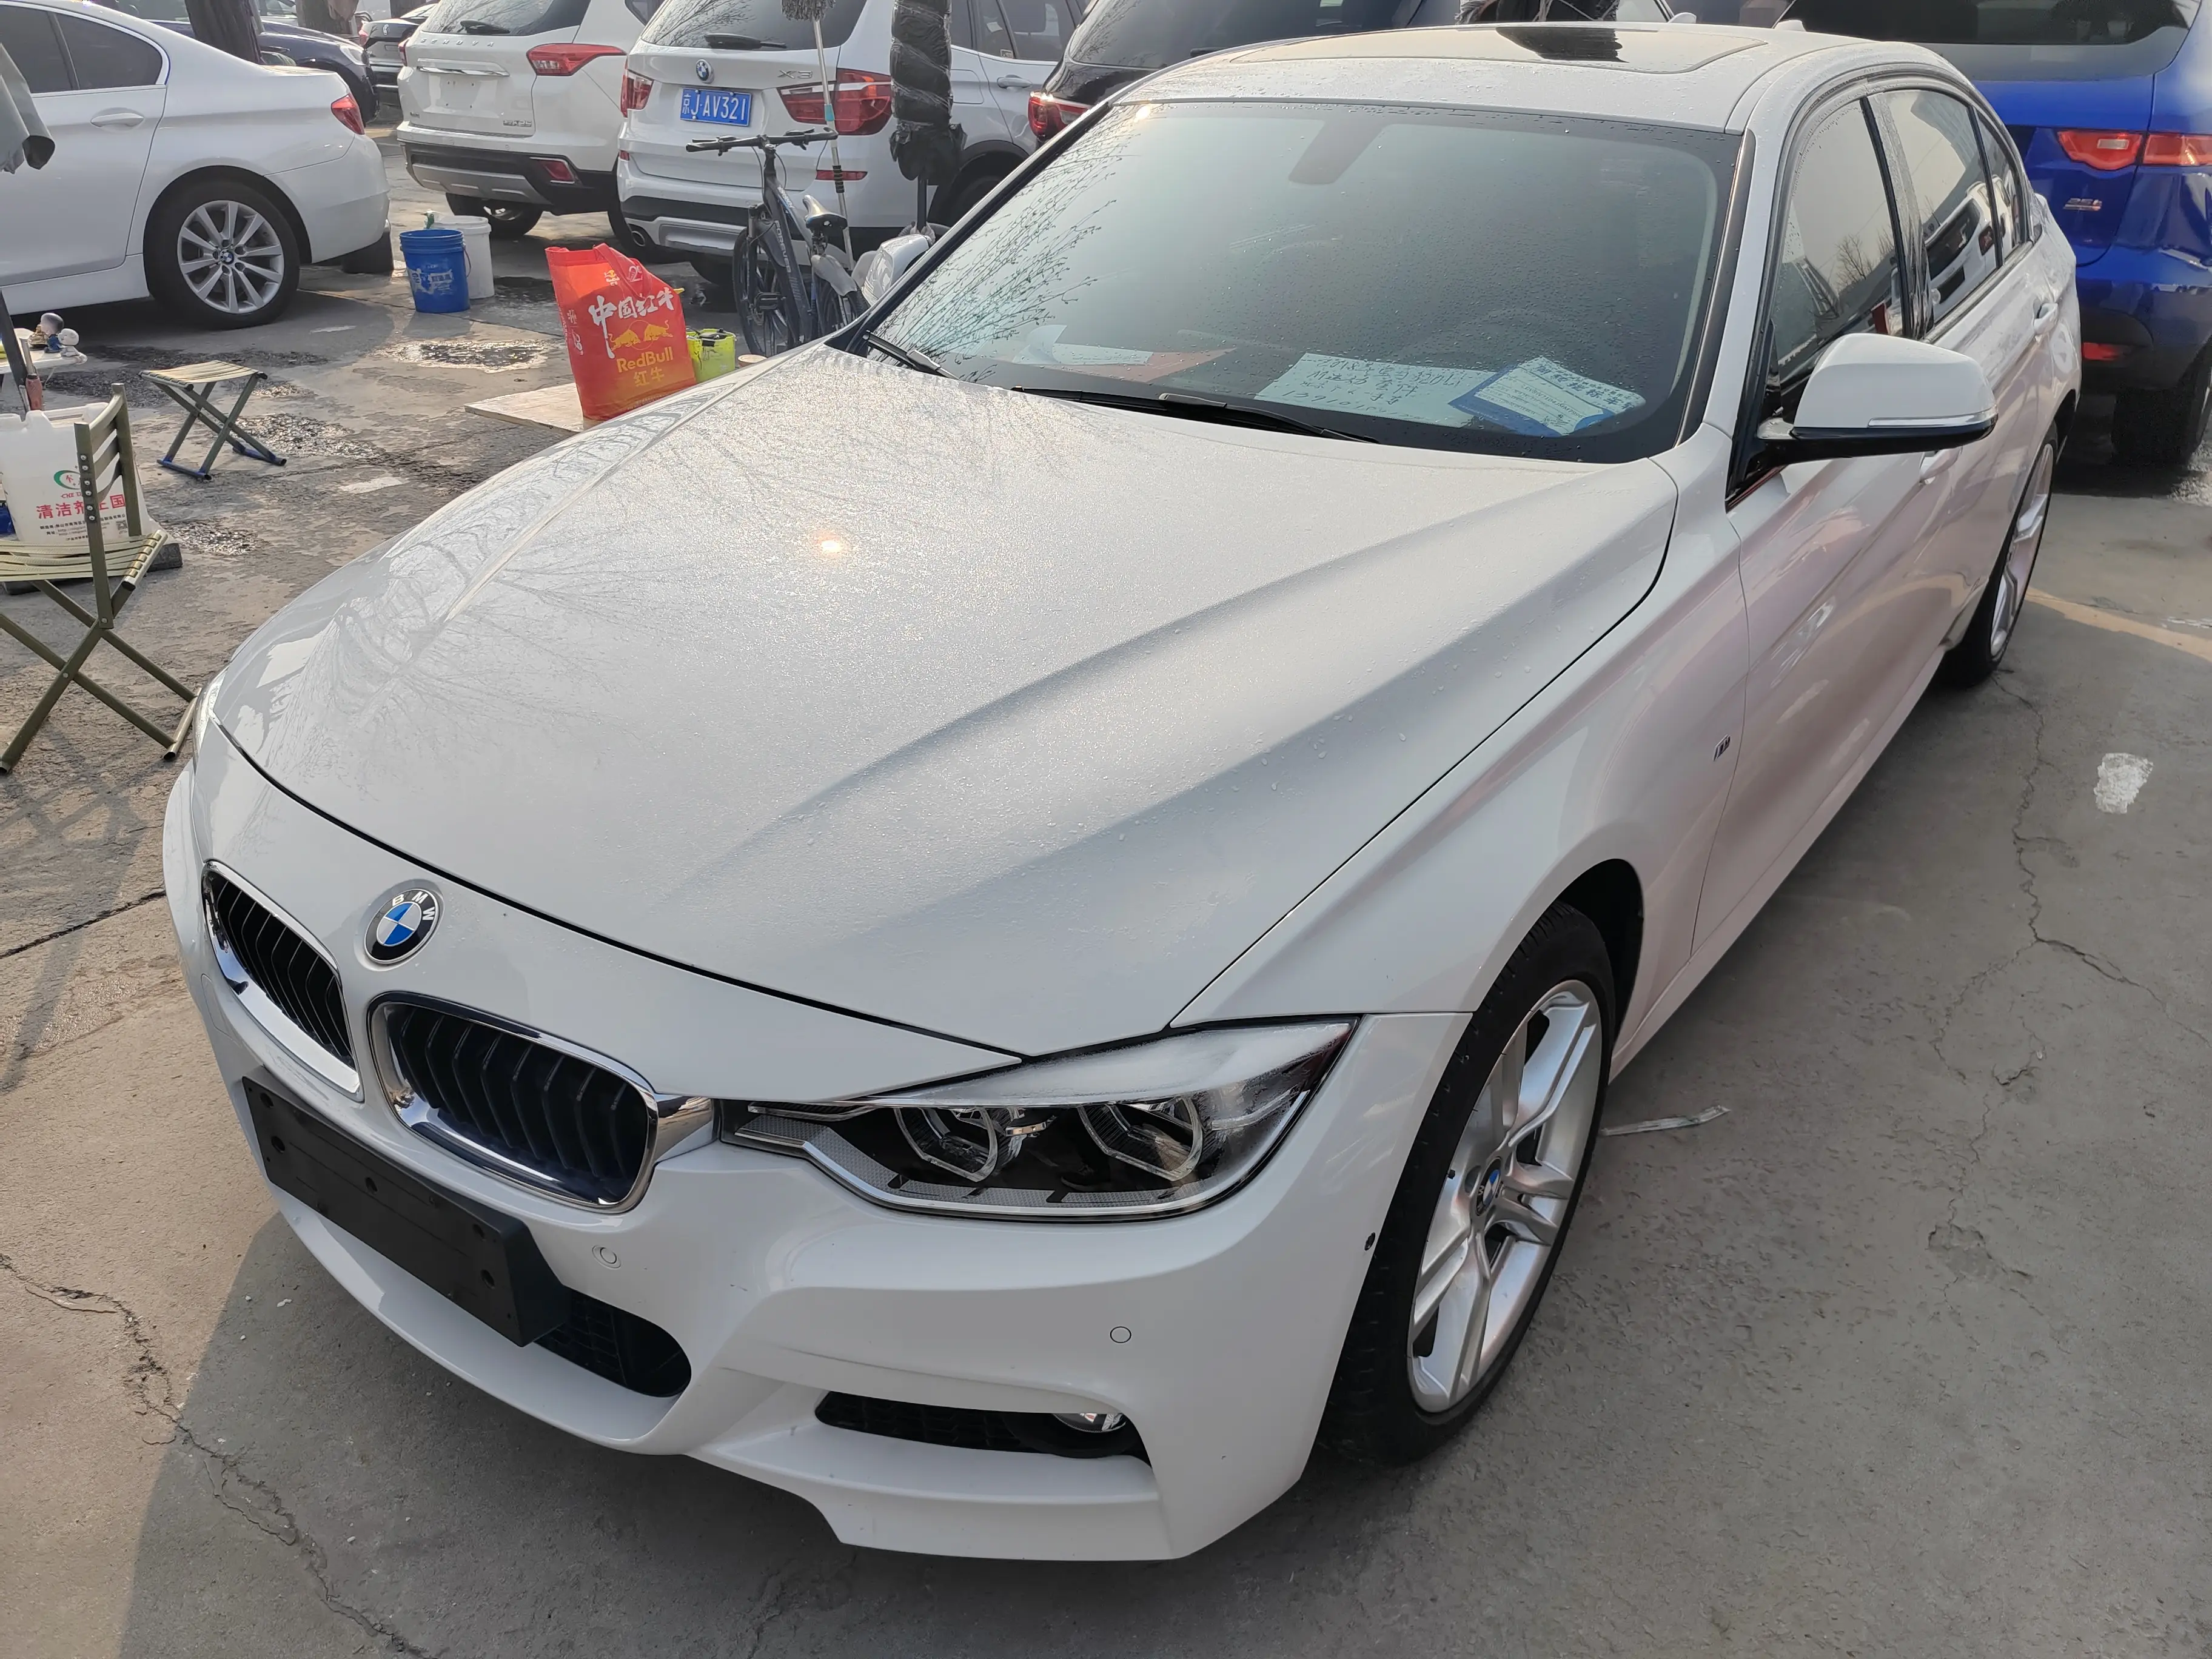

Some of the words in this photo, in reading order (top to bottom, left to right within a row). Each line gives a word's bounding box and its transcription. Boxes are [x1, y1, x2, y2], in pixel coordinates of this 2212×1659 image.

[420, 38, 495, 47] SENOVA
[778, 70, 813, 79] X3
[775, 220, 791, 273] FOREVER
[588, 287, 674, 359] 中国红牛
[617, 347, 674, 373] RedBull
[634, 367, 665, 386] 红牛
[392, 891, 435, 920] BMW
